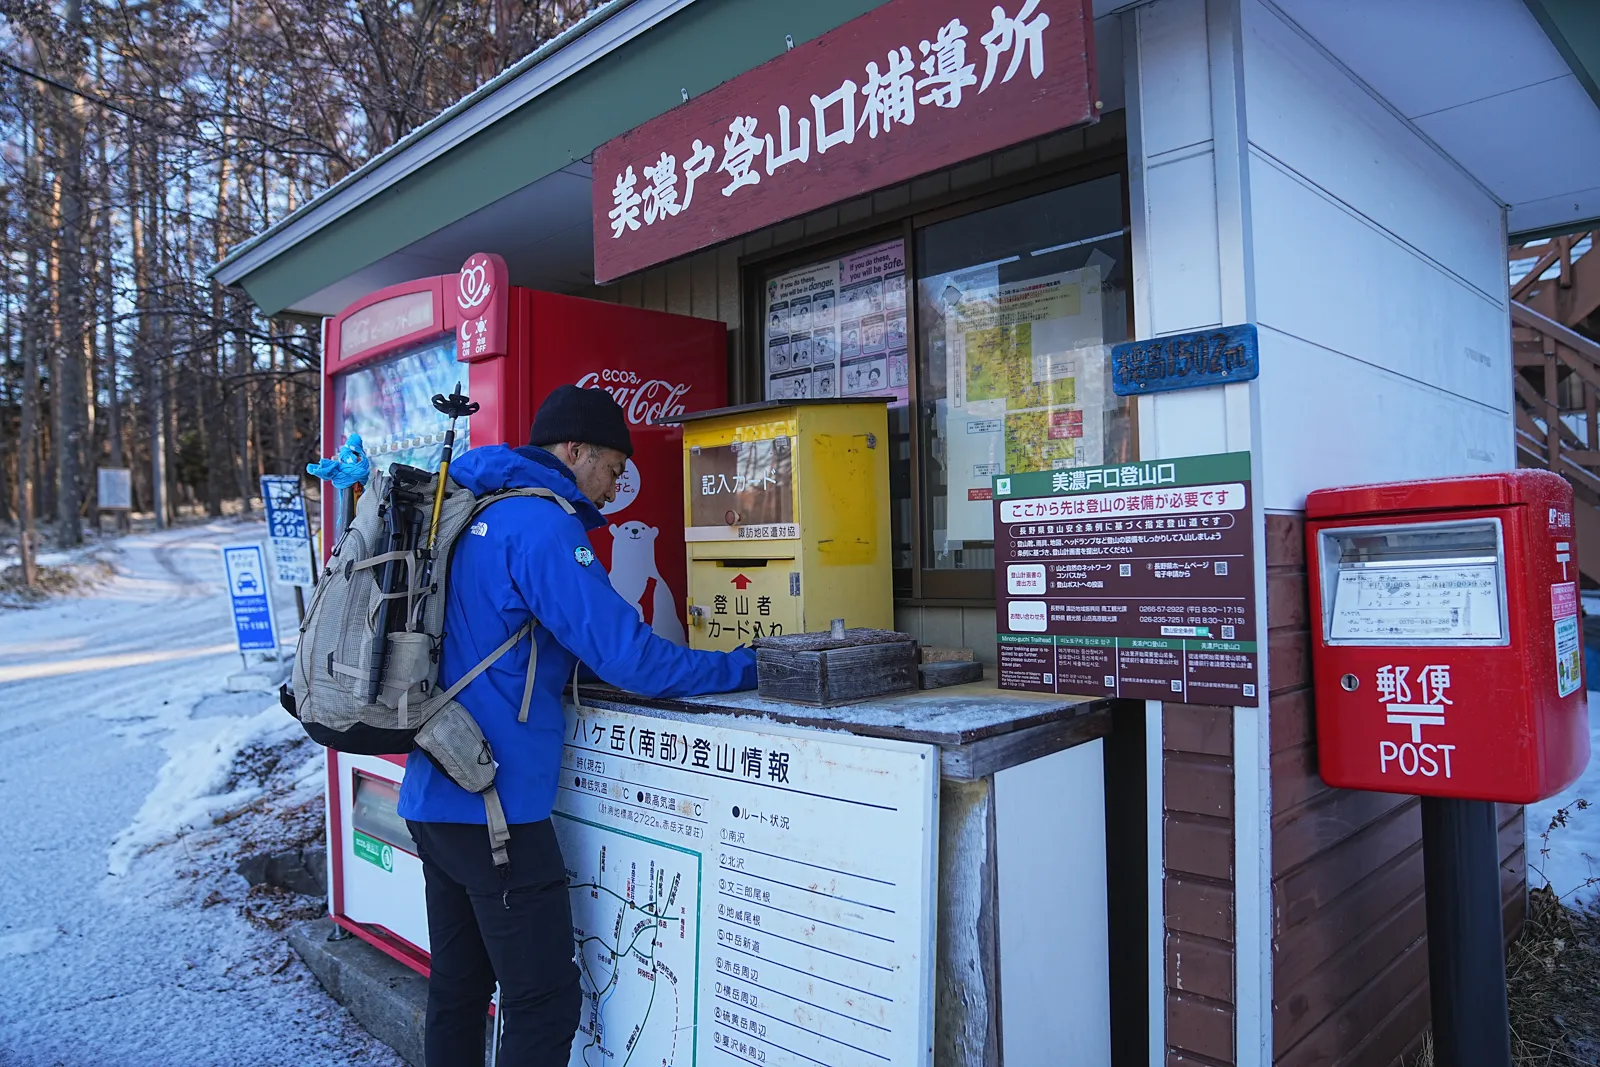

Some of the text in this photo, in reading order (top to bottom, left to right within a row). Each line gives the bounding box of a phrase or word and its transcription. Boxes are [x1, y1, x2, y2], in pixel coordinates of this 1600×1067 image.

[883, 258, 904, 271] safe.
[808, 278, 835, 292] danger.
[462, 349, 470, 357] ON
[475, 345, 487, 354] OFF
[702, 468, 777, 496] 記入カード
[1052, 463, 1176, 492] 美濃戸口登山口
[1012, 489, 1230, 518] ここから先は登山の装備が必要です
[738, 526, 796, 539] 諏訪地区遭対協
[1019, 516, 1221, 536] 長野県登山安全条例に基づく指定登山道です
[714, 594, 772, 616] 登山者
[1139, 616, 1184, 624] 026-235-7251
[1376, 664, 1453, 705] 郵便
[1379, 740, 1456, 779] POST
[720, 828, 746, 844] ①南沢
[719, 853, 745, 869] ②北沢
[719, 878, 771, 904] ③文三郎尾根
[717, 928, 761, 954] ⑤中岳新道
[716, 956, 759, 982] ⑥赤岳周辺
[714, 981, 758, 1008] ⑦横岳周辺
